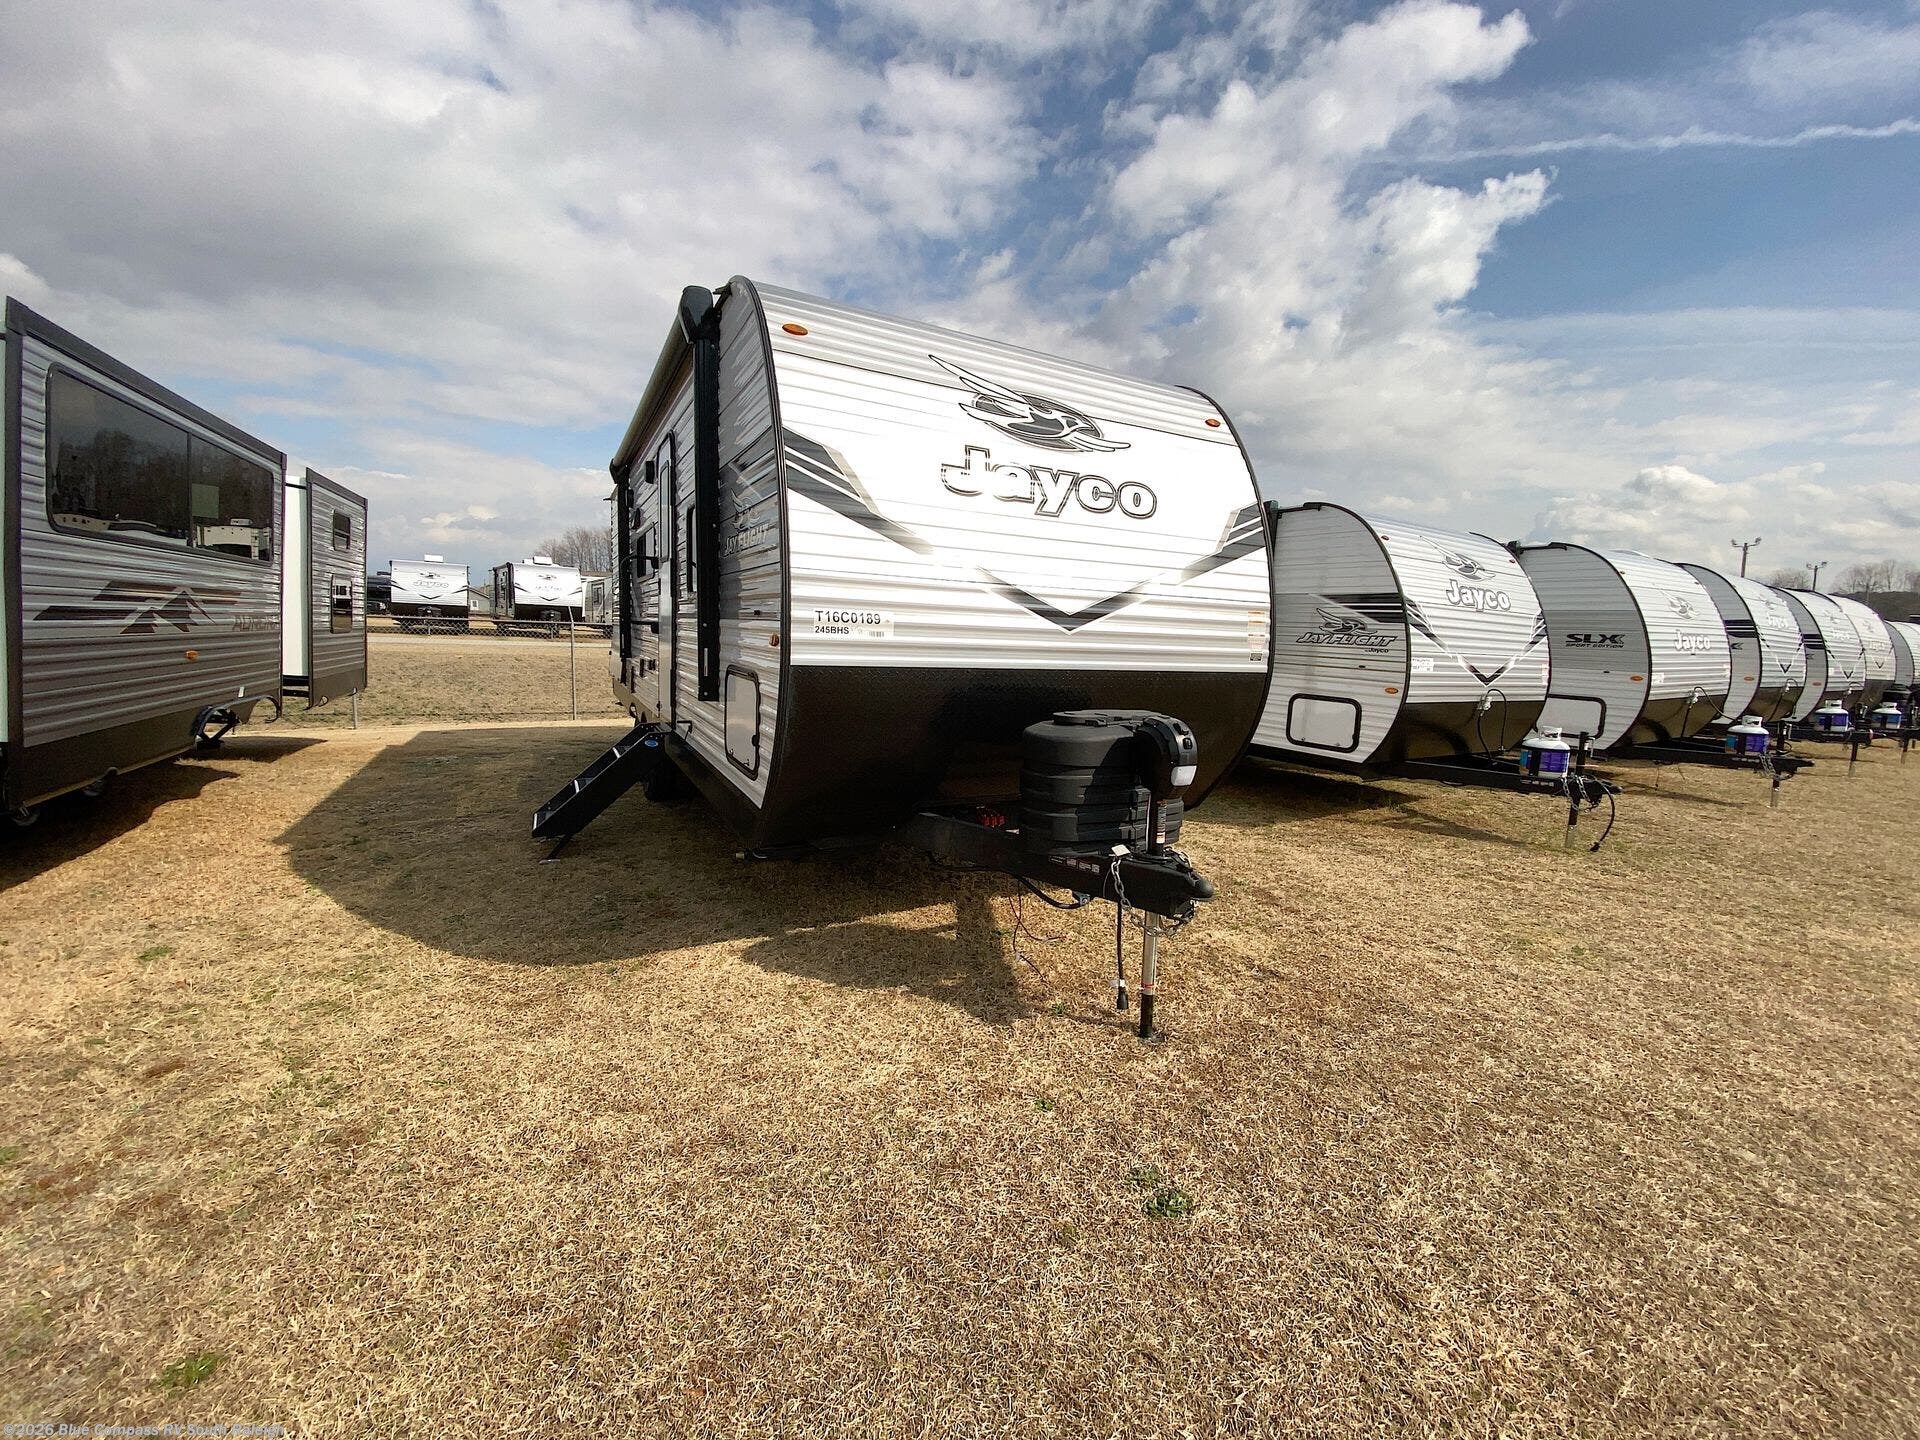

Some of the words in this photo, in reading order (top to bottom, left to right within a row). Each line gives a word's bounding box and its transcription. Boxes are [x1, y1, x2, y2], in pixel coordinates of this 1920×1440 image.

[941, 445, 1157, 519] Jayco
[1446, 579, 1511, 612] Jayco
[815, 610, 881, 625] T16C0189
[815, 626, 849, 634] 245BHS
[1296, 632, 1330, 643] JAY
[1329, 634, 1398, 647] FLIGHT
[1565, 633, 1626, 643] SLX
[1674, 629, 1711, 655] Jayco
